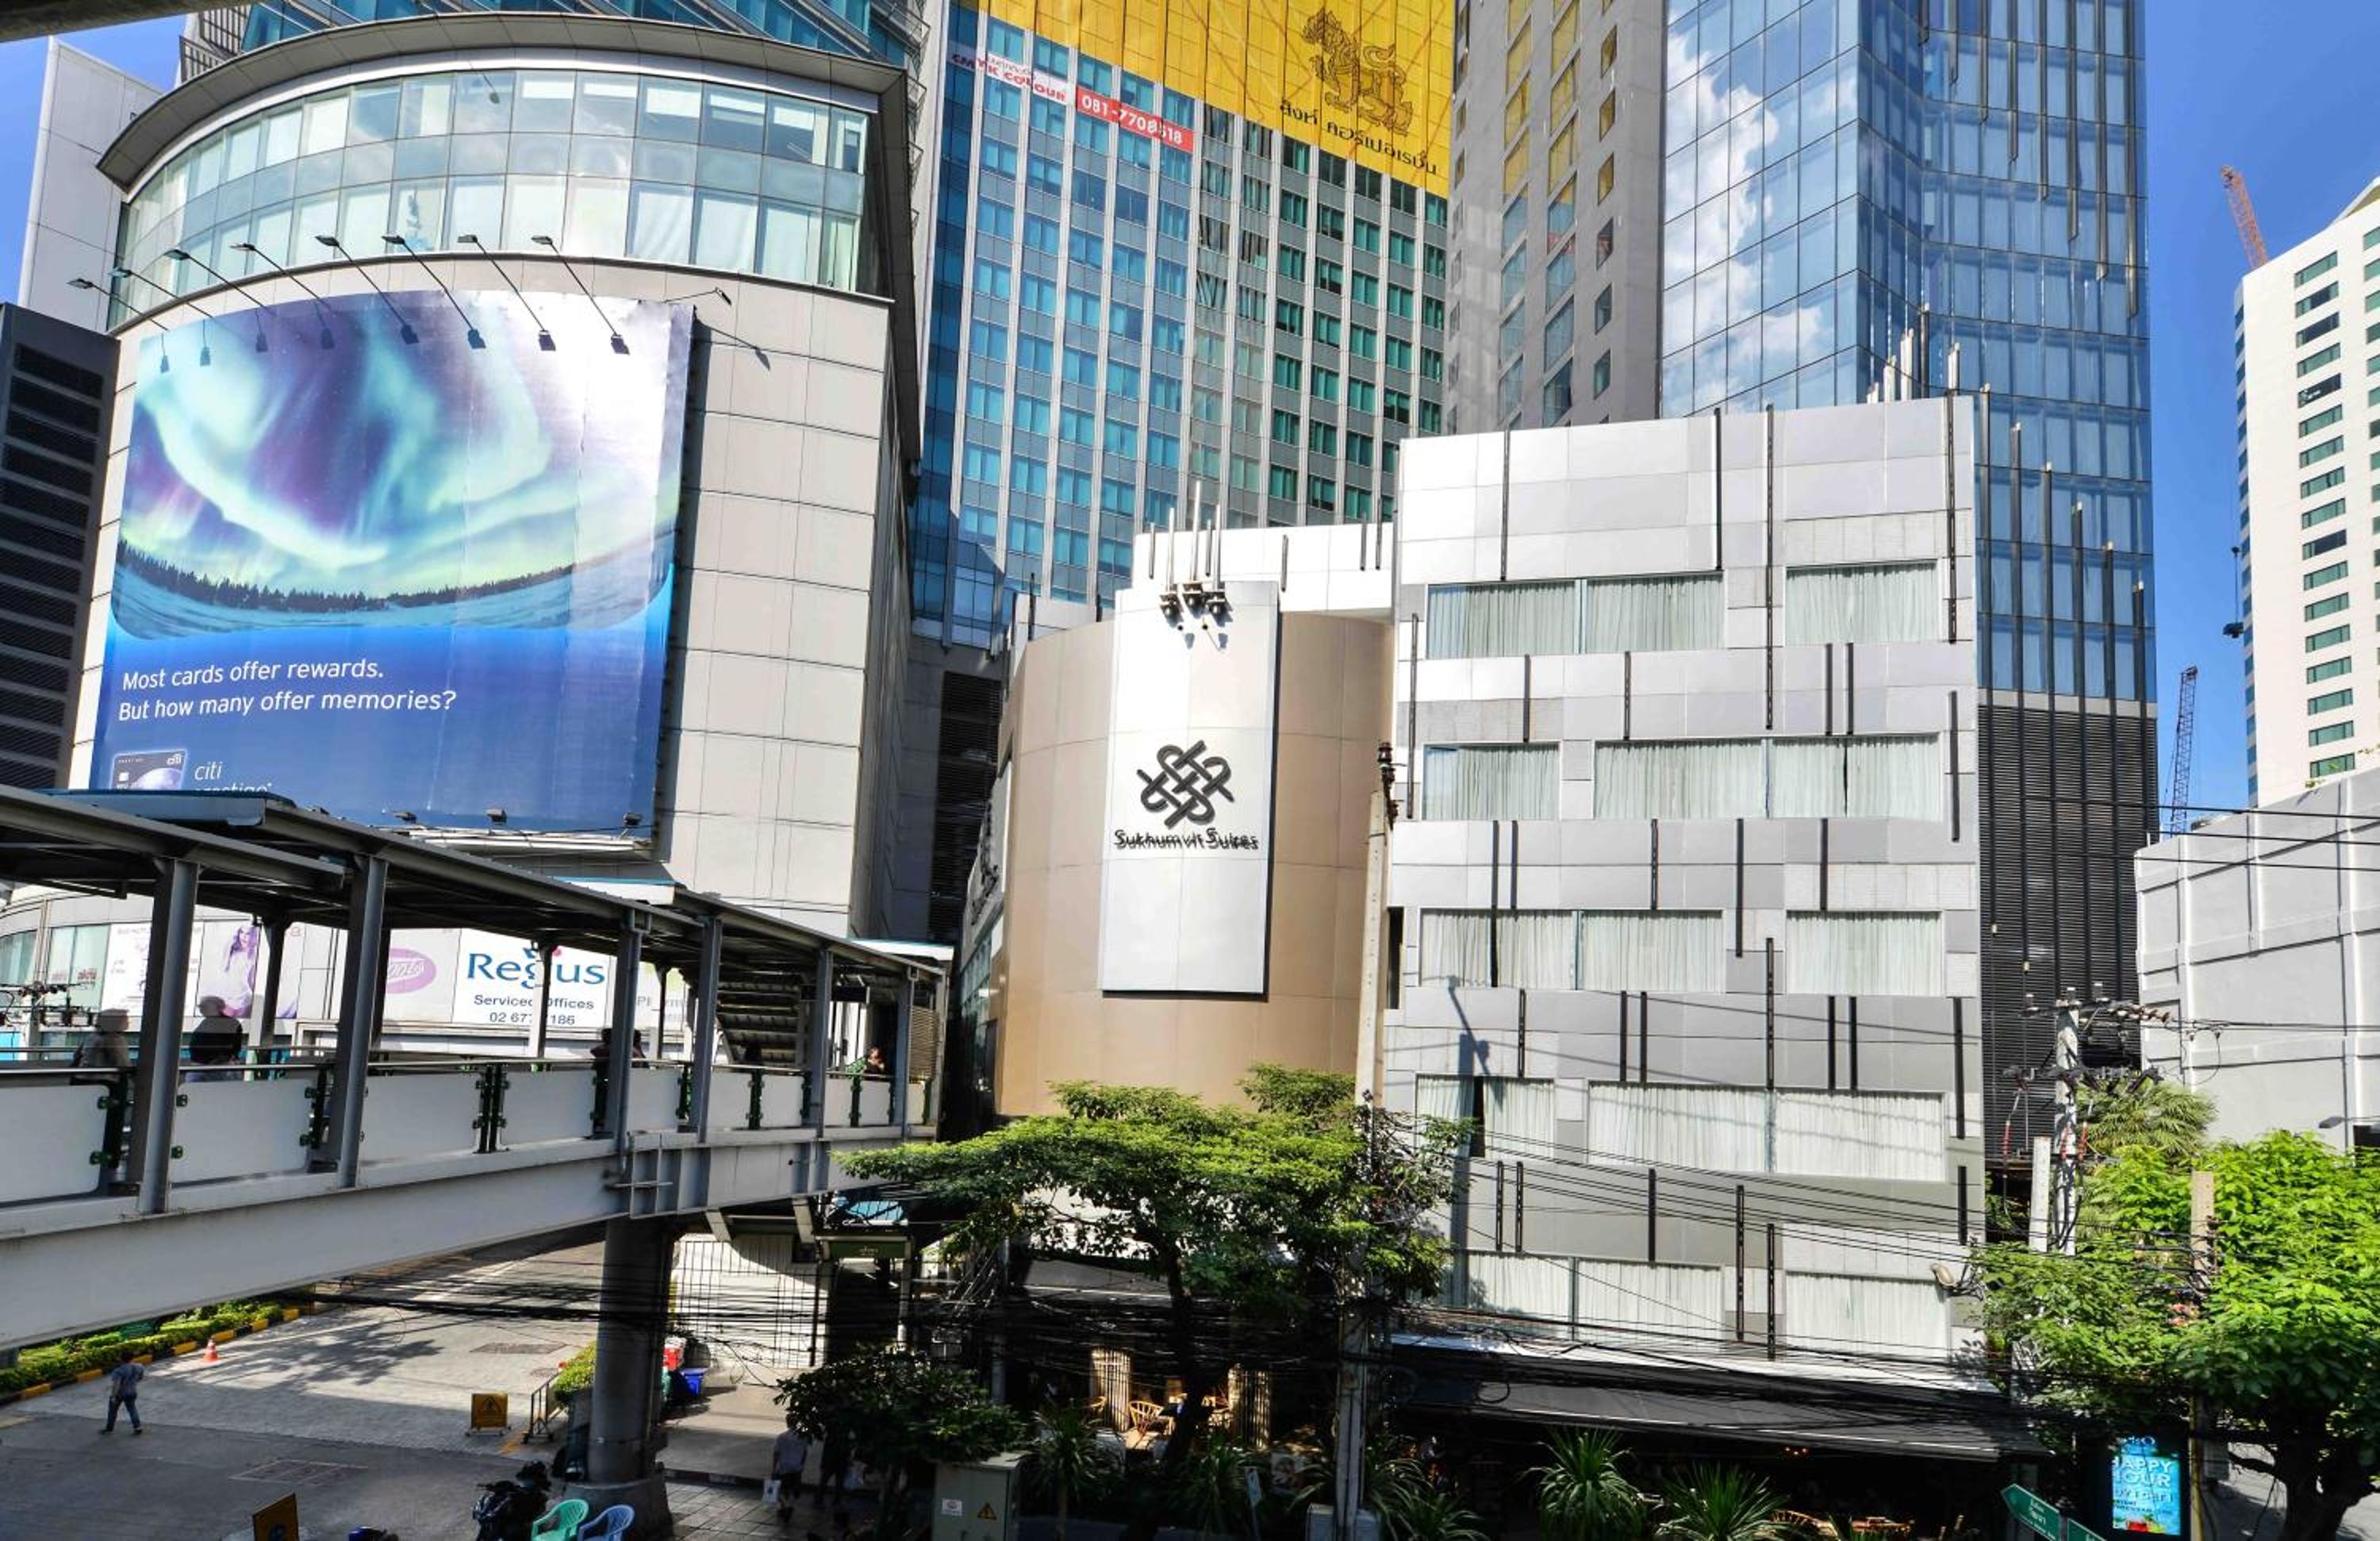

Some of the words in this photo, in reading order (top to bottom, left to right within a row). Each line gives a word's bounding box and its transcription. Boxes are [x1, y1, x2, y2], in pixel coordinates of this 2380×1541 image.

[123, 668, 166, 690] Most
[171, 664, 224, 686] cards
[229, 660, 281, 682] offer
[287, 658, 384, 679] rewards.
[119, 699, 150, 721] But
[155, 699, 194, 718] how
[199, 696, 255, 717] many
[261, 690, 316, 711] offer
[321, 690, 458, 711] memories?
[194, 761, 223, 781] citi
[1114, 829, 1204, 849] Sukhumvit
[489, 1012, 507, 1024] 02
